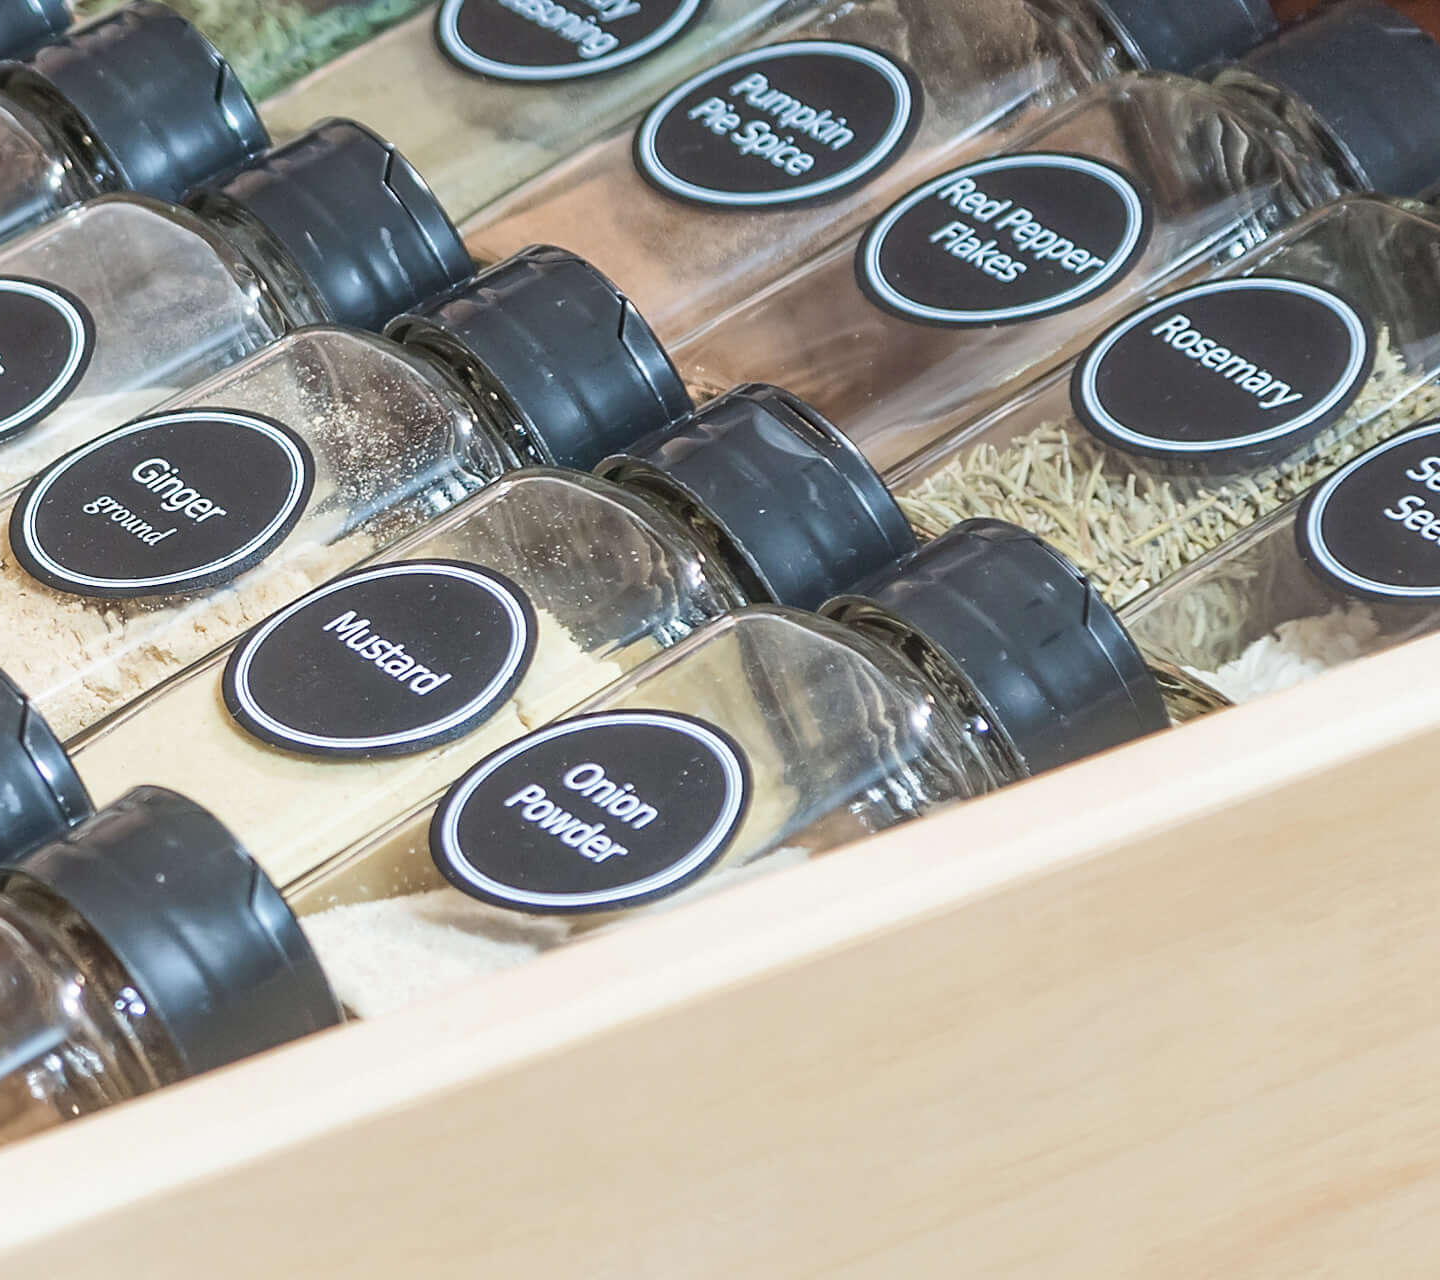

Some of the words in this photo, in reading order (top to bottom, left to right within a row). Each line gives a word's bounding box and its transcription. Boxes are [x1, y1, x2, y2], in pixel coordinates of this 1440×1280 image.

[688, 98, 741, 136] Pie
[731, 122, 817, 177] Spice
[730, 72, 857, 152] Pumpkin
[930, 219, 1027, 285] Flakes
[938, 178, 1012, 219] Red
[994, 210, 1107, 275] Pepper
[1152, 313, 1303, 410] Rosemary
[83, 495, 178, 549] ground
[130, 458, 227, 526] Ginger
[322, 609, 452, 698] Mustard
[504, 784, 629, 865] Powder
[563, 762, 660, 830] Onion
